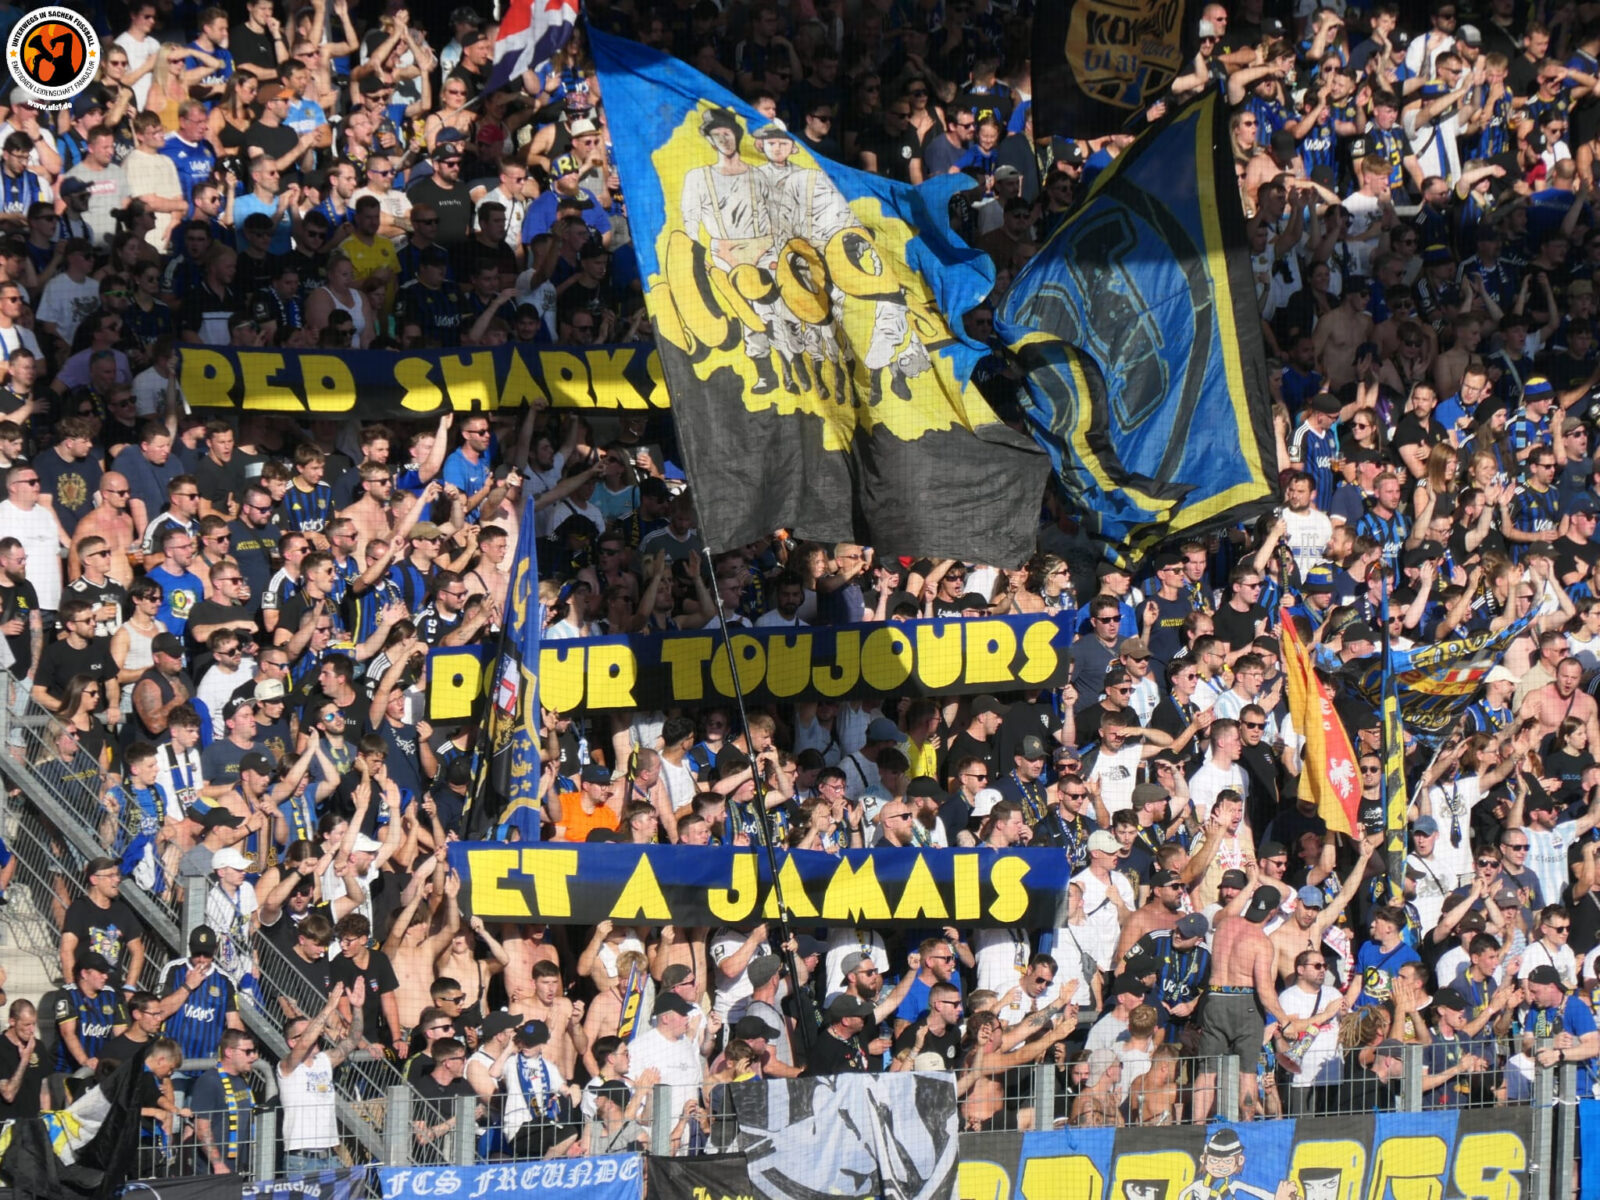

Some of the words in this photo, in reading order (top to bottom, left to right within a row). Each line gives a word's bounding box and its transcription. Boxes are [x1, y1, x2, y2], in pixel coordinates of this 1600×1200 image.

[180, 348, 357, 412] RED
[429, 643, 638, 720] PUR
[661, 619, 1060, 698] TOUJOURS
[468, 849, 578, 918] ET
[608, 851, 672, 920] A
[708, 851, 1031, 923] JAMAIS
[383, 1169, 462, 1200] FCS
[469, 1155, 641, 1198] FREUNDE
